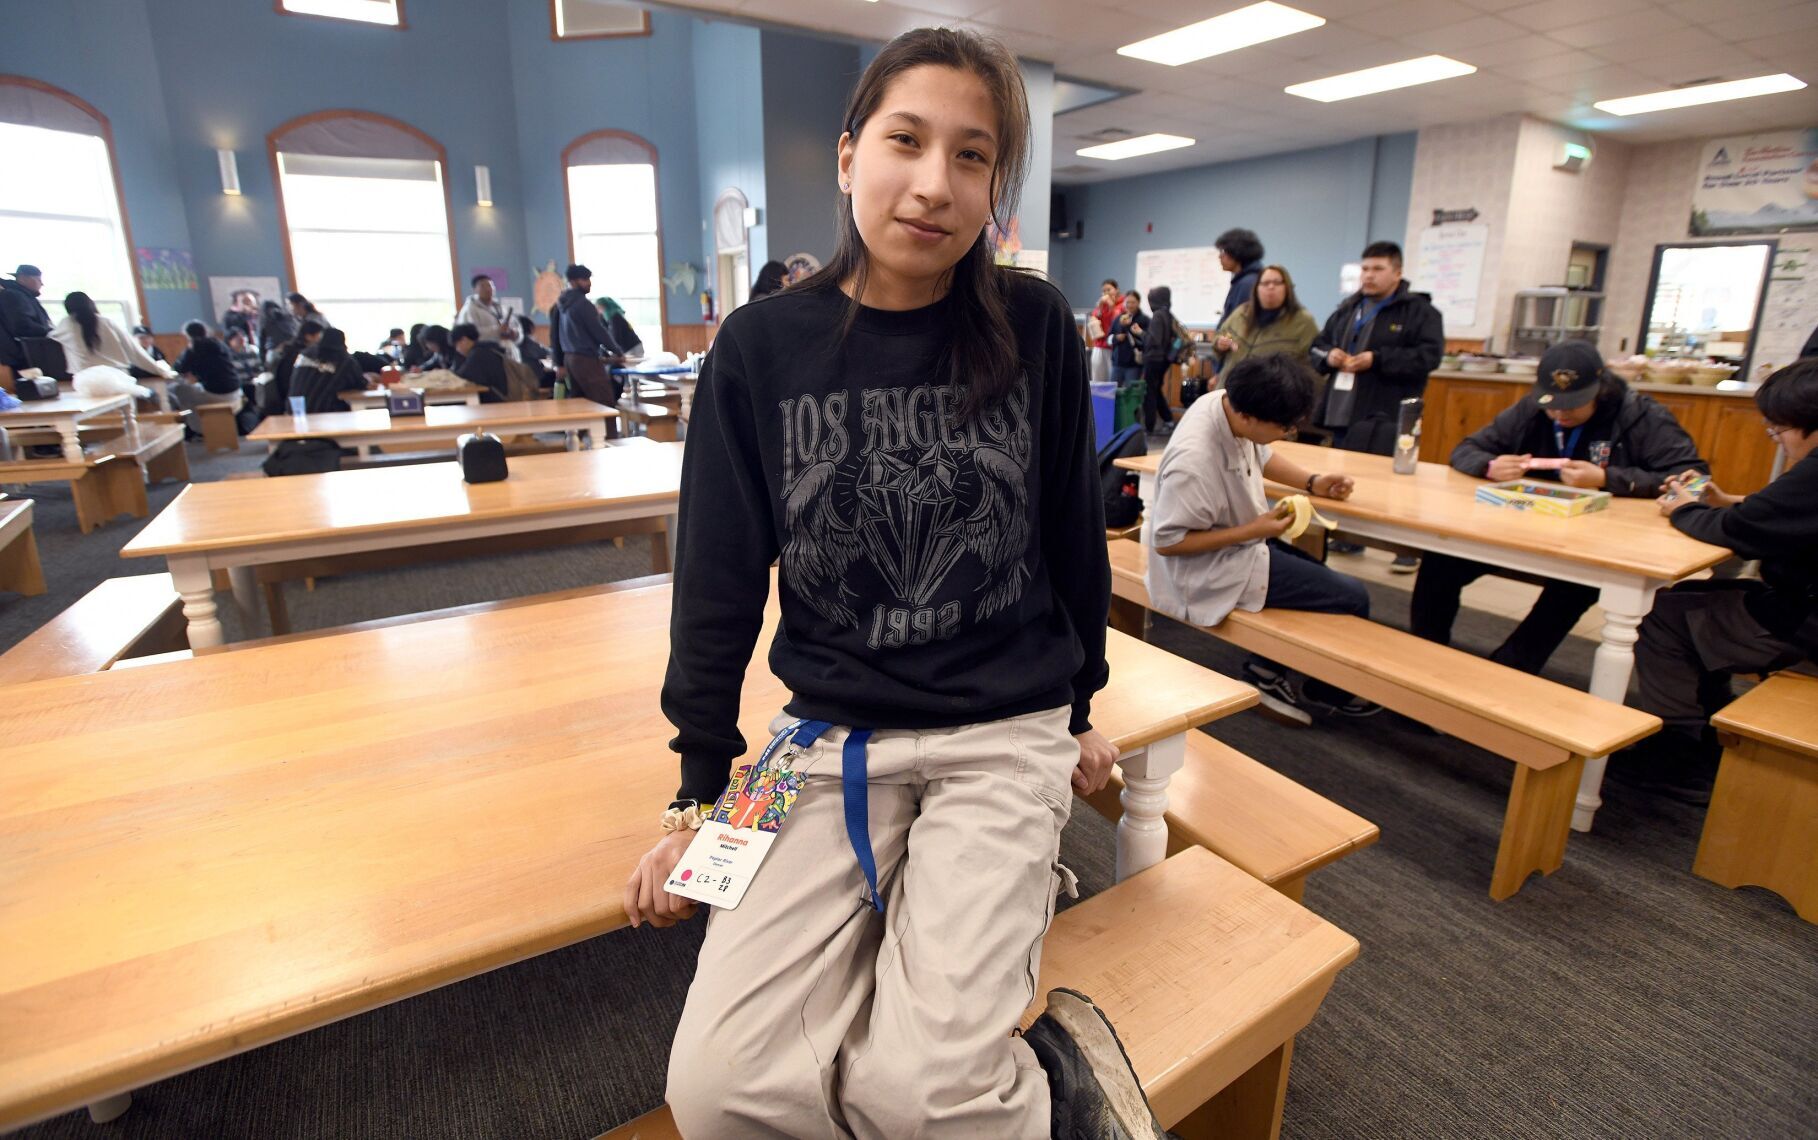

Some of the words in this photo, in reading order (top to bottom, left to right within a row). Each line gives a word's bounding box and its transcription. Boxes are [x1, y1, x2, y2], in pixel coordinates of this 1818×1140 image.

[779, 389, 849, 500] LOS
[866, 599, 962, 650] 1992
[718, 833, 748, 846] Rihanna
[720, 843, 738, 851] Mitchell
